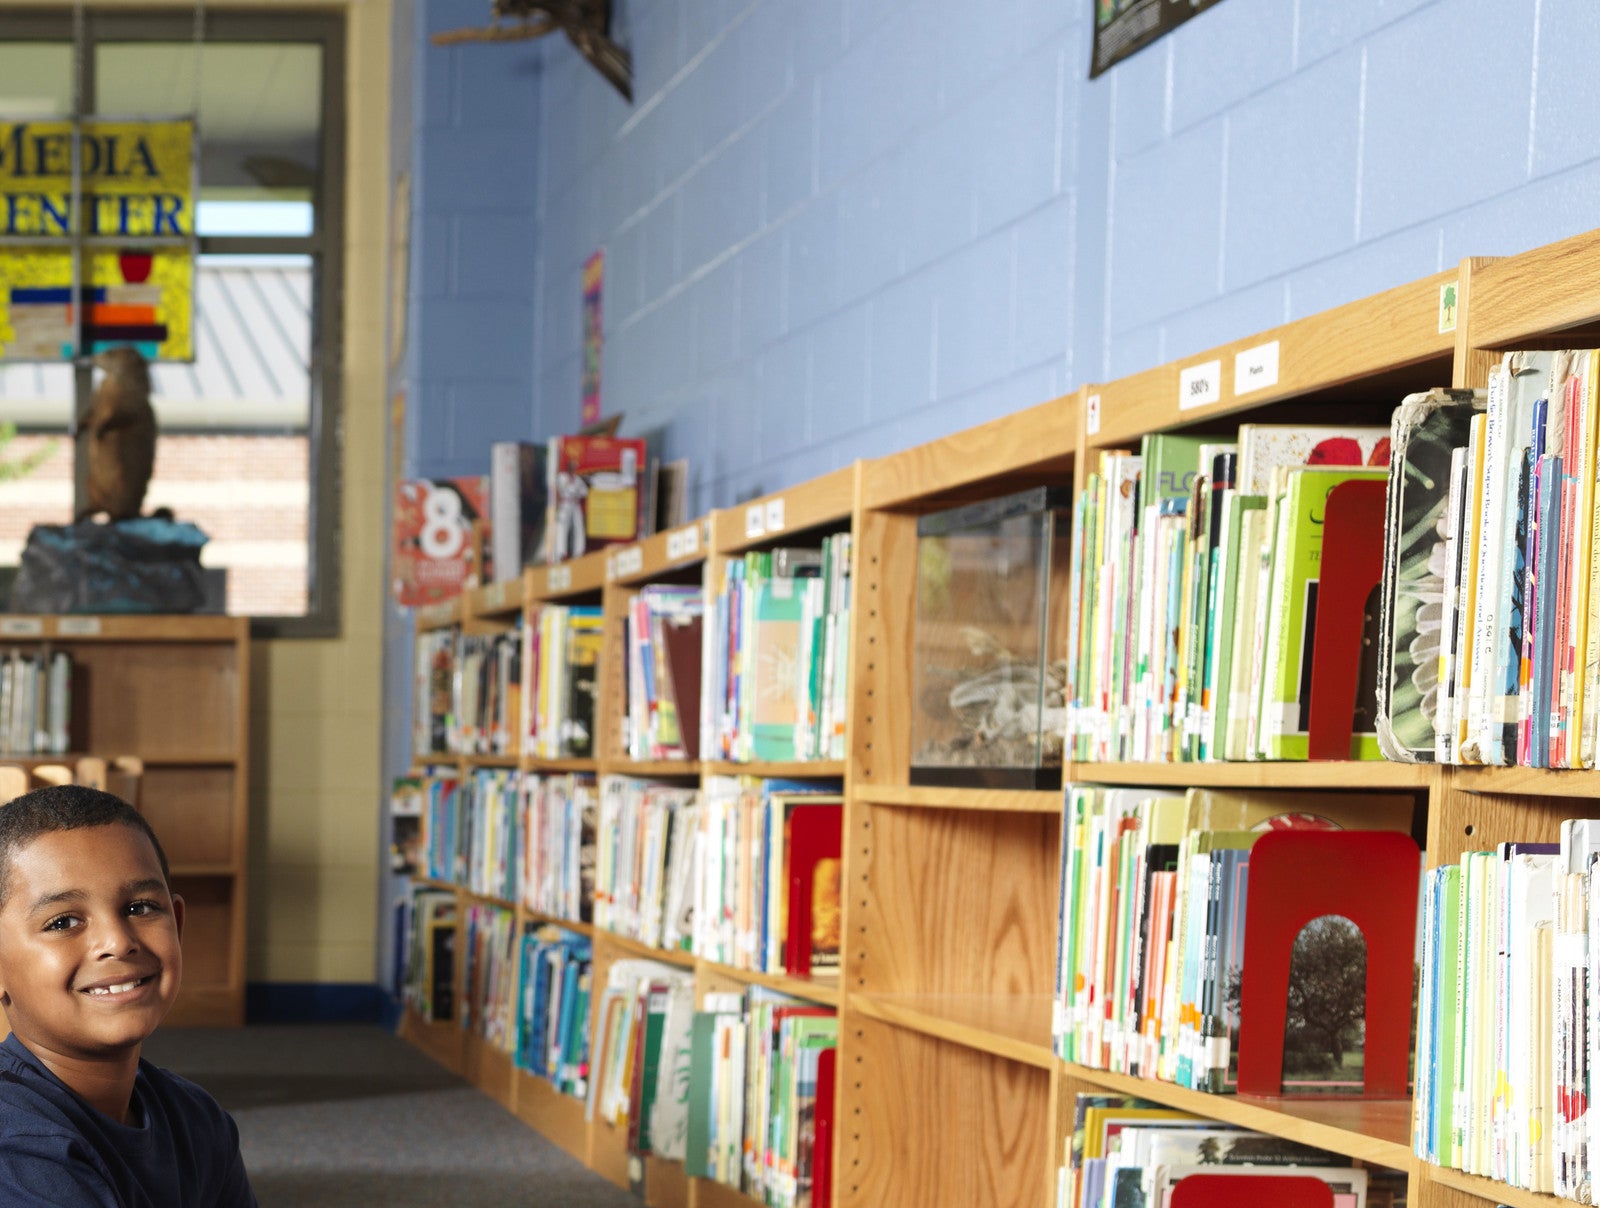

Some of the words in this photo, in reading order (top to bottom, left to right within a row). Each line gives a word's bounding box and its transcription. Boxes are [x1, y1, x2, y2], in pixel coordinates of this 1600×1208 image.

[1490, 375, 1498, 416] Charlie
[1488, 419, 1496, 463] Brown's
[1485, 464, 1493, 496] Super
[1480, 544, 1488, 600] Questions
[1504, 555, 1513, 604] ANIMALS
